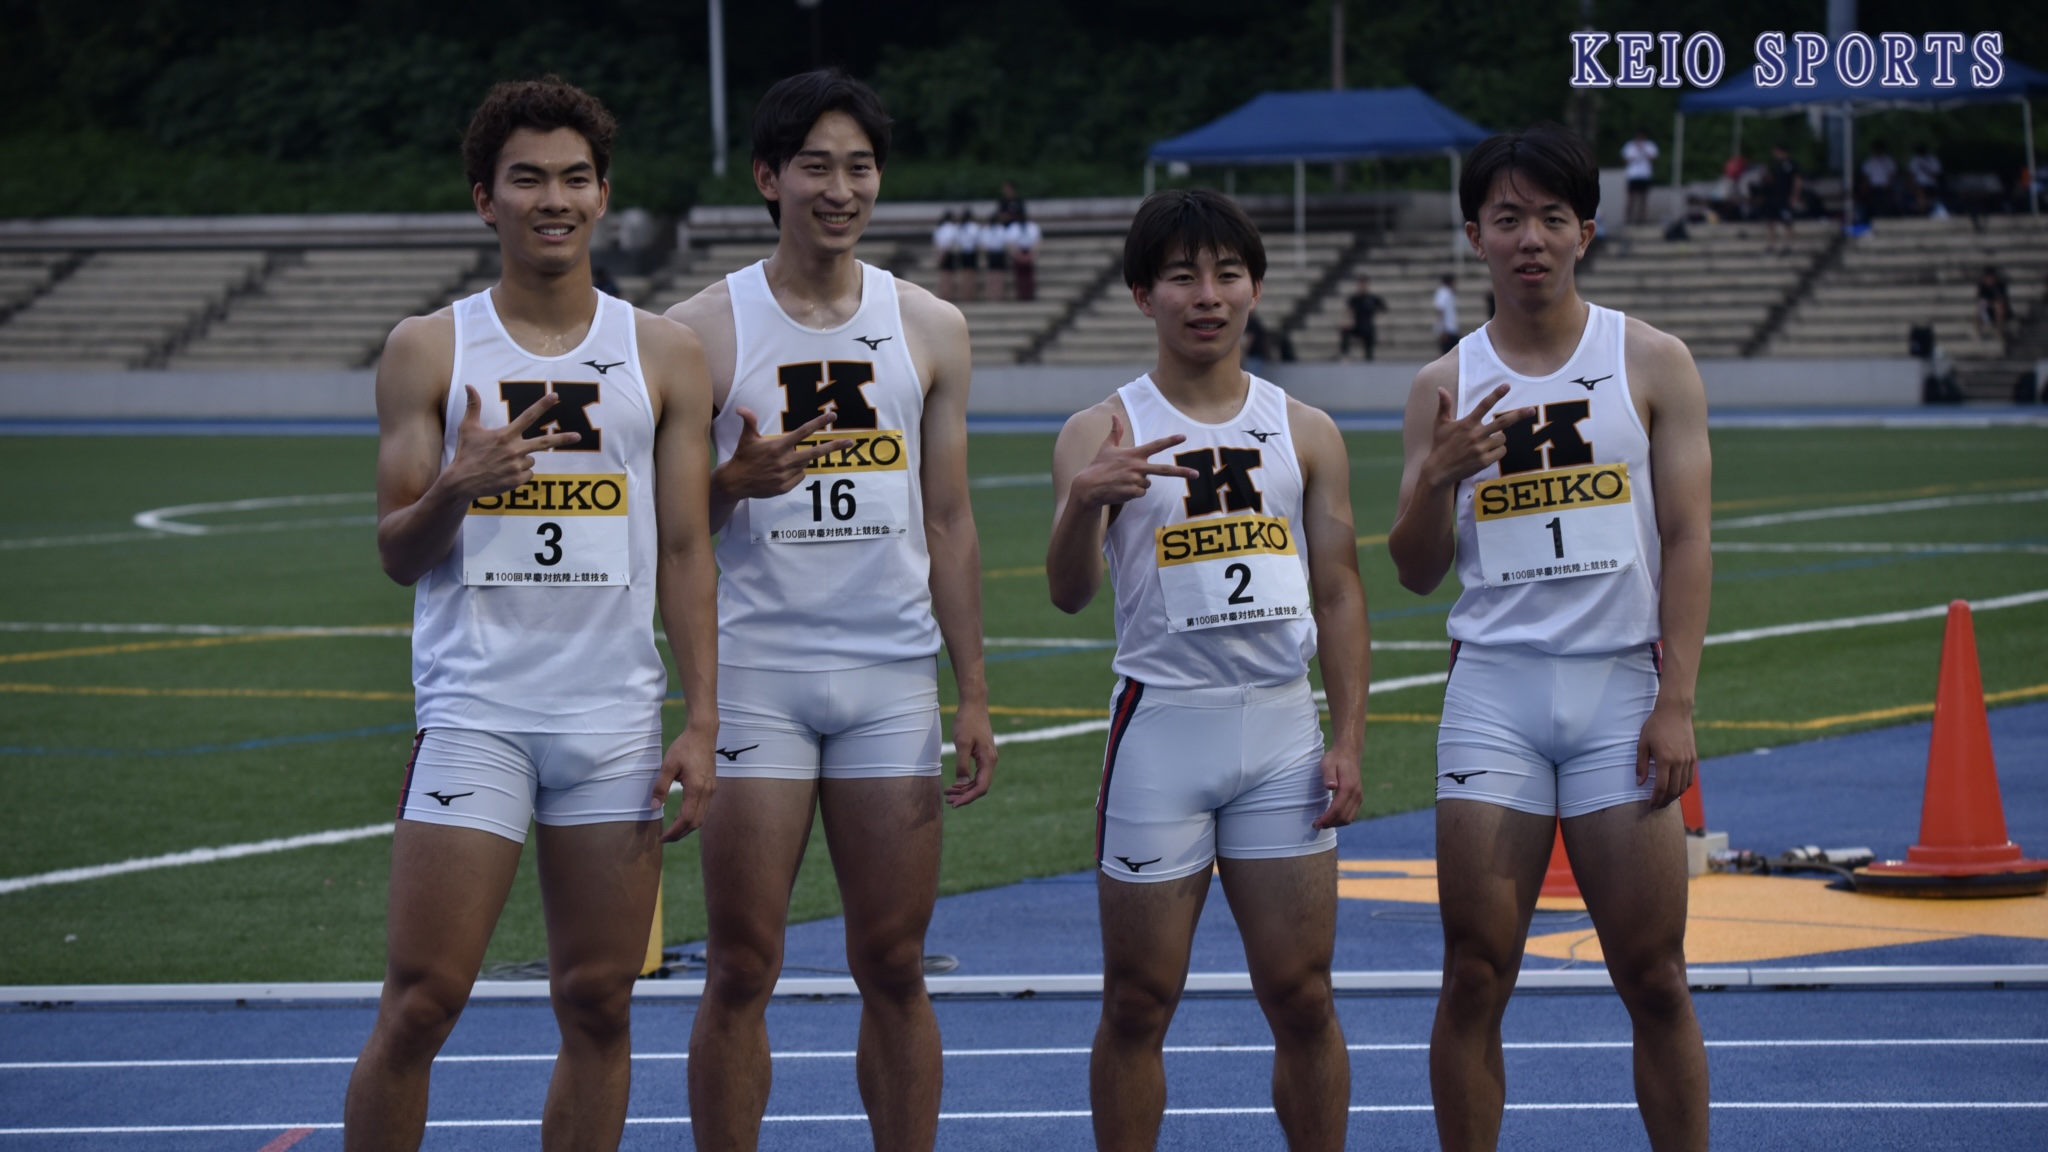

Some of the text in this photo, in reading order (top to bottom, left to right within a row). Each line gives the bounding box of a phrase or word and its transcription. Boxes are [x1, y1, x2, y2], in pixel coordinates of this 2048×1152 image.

[499, 380, 602, 453] K
[777, 360, 878, 433] K
[1491, 399, 1594, 477] K
[806, 479, 857, 522] 16
[1173, 446, 1263, 518] K
[1481, 470, 1623, 515] SEIKO
[534, 522, 563, 566] 3
[770, 525, 890, 540] 第100回早慶対抗陸上競技会
[1162, 521, 1288, 560] SEIKO
[1545, 517, 1564, 559] 1
[485, 572, 609, 582] 第100回早慶対抗陸上競技会
[1224, 563, 1254, 605] 2
[1501, 559, 1619, 582] 第100回早慶対抗陸上競技会
[1186, 606, 1298, 627] 第100回早慶対抗陸上競技会
